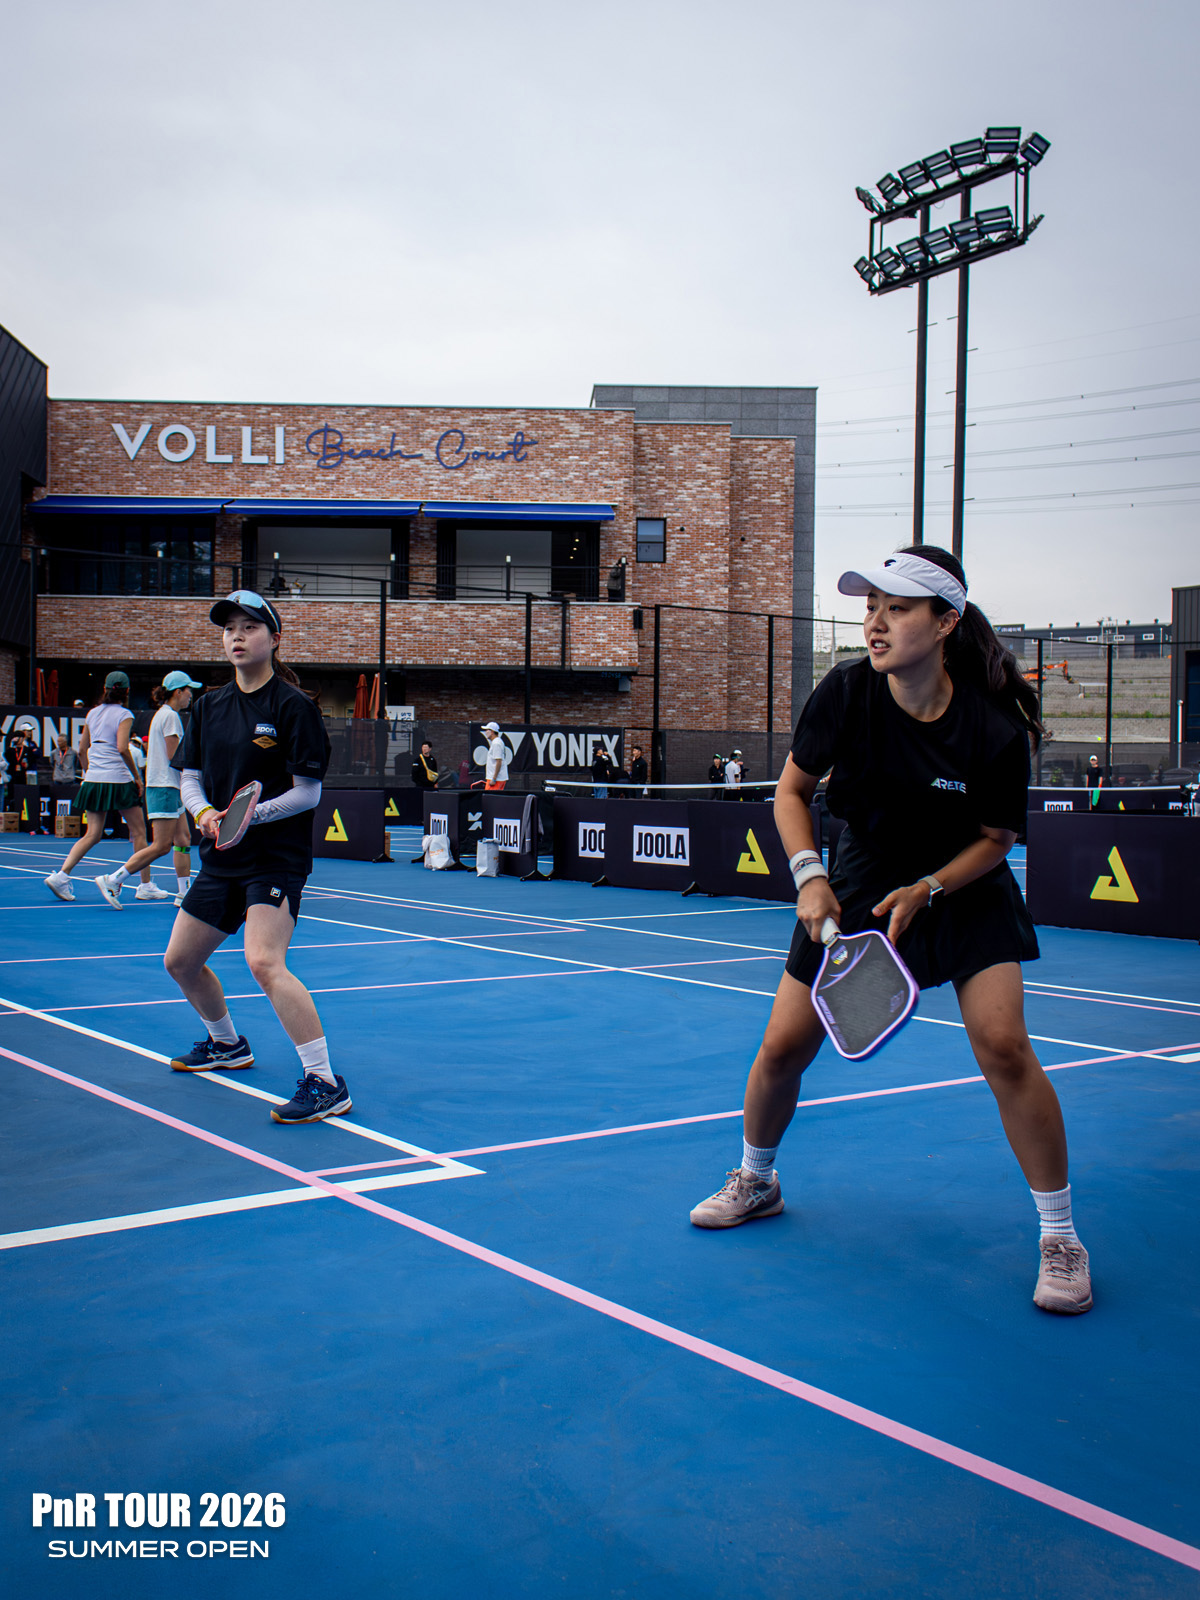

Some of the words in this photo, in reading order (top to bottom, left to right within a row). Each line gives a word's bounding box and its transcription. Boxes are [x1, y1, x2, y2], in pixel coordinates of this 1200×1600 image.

[111, 423, 285, 464] VOLLI
[306, 423, 423, 469] Beach
[436, 429, 538, 469] Court
[931, 777, 966, 793] ARETE
[635, 832, 687, 859] JOOLA
